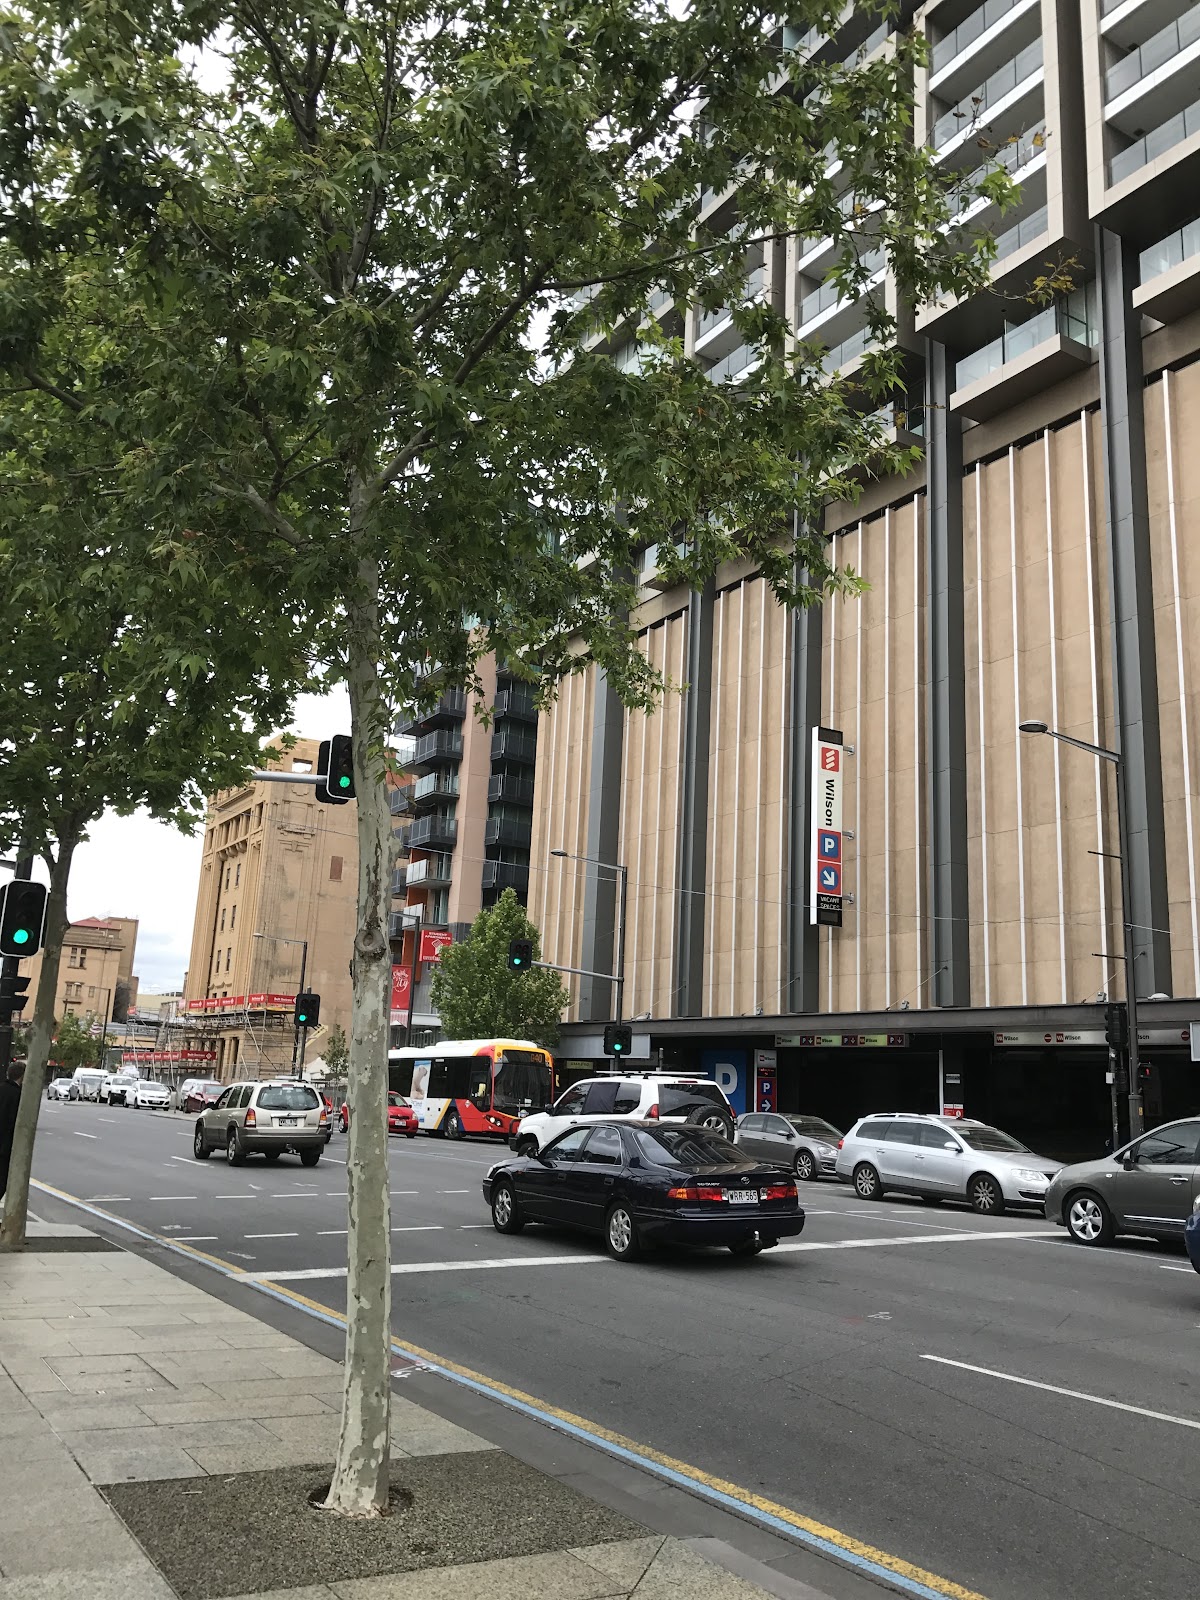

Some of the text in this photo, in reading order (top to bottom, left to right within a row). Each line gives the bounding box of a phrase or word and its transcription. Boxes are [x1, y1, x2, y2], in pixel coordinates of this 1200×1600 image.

[825, 779, 834, 827] Wilson
[825, 837, 835, 853] P
[530, 1053, 543, 1063] G40
[763, 1082, 771, 1093] P
